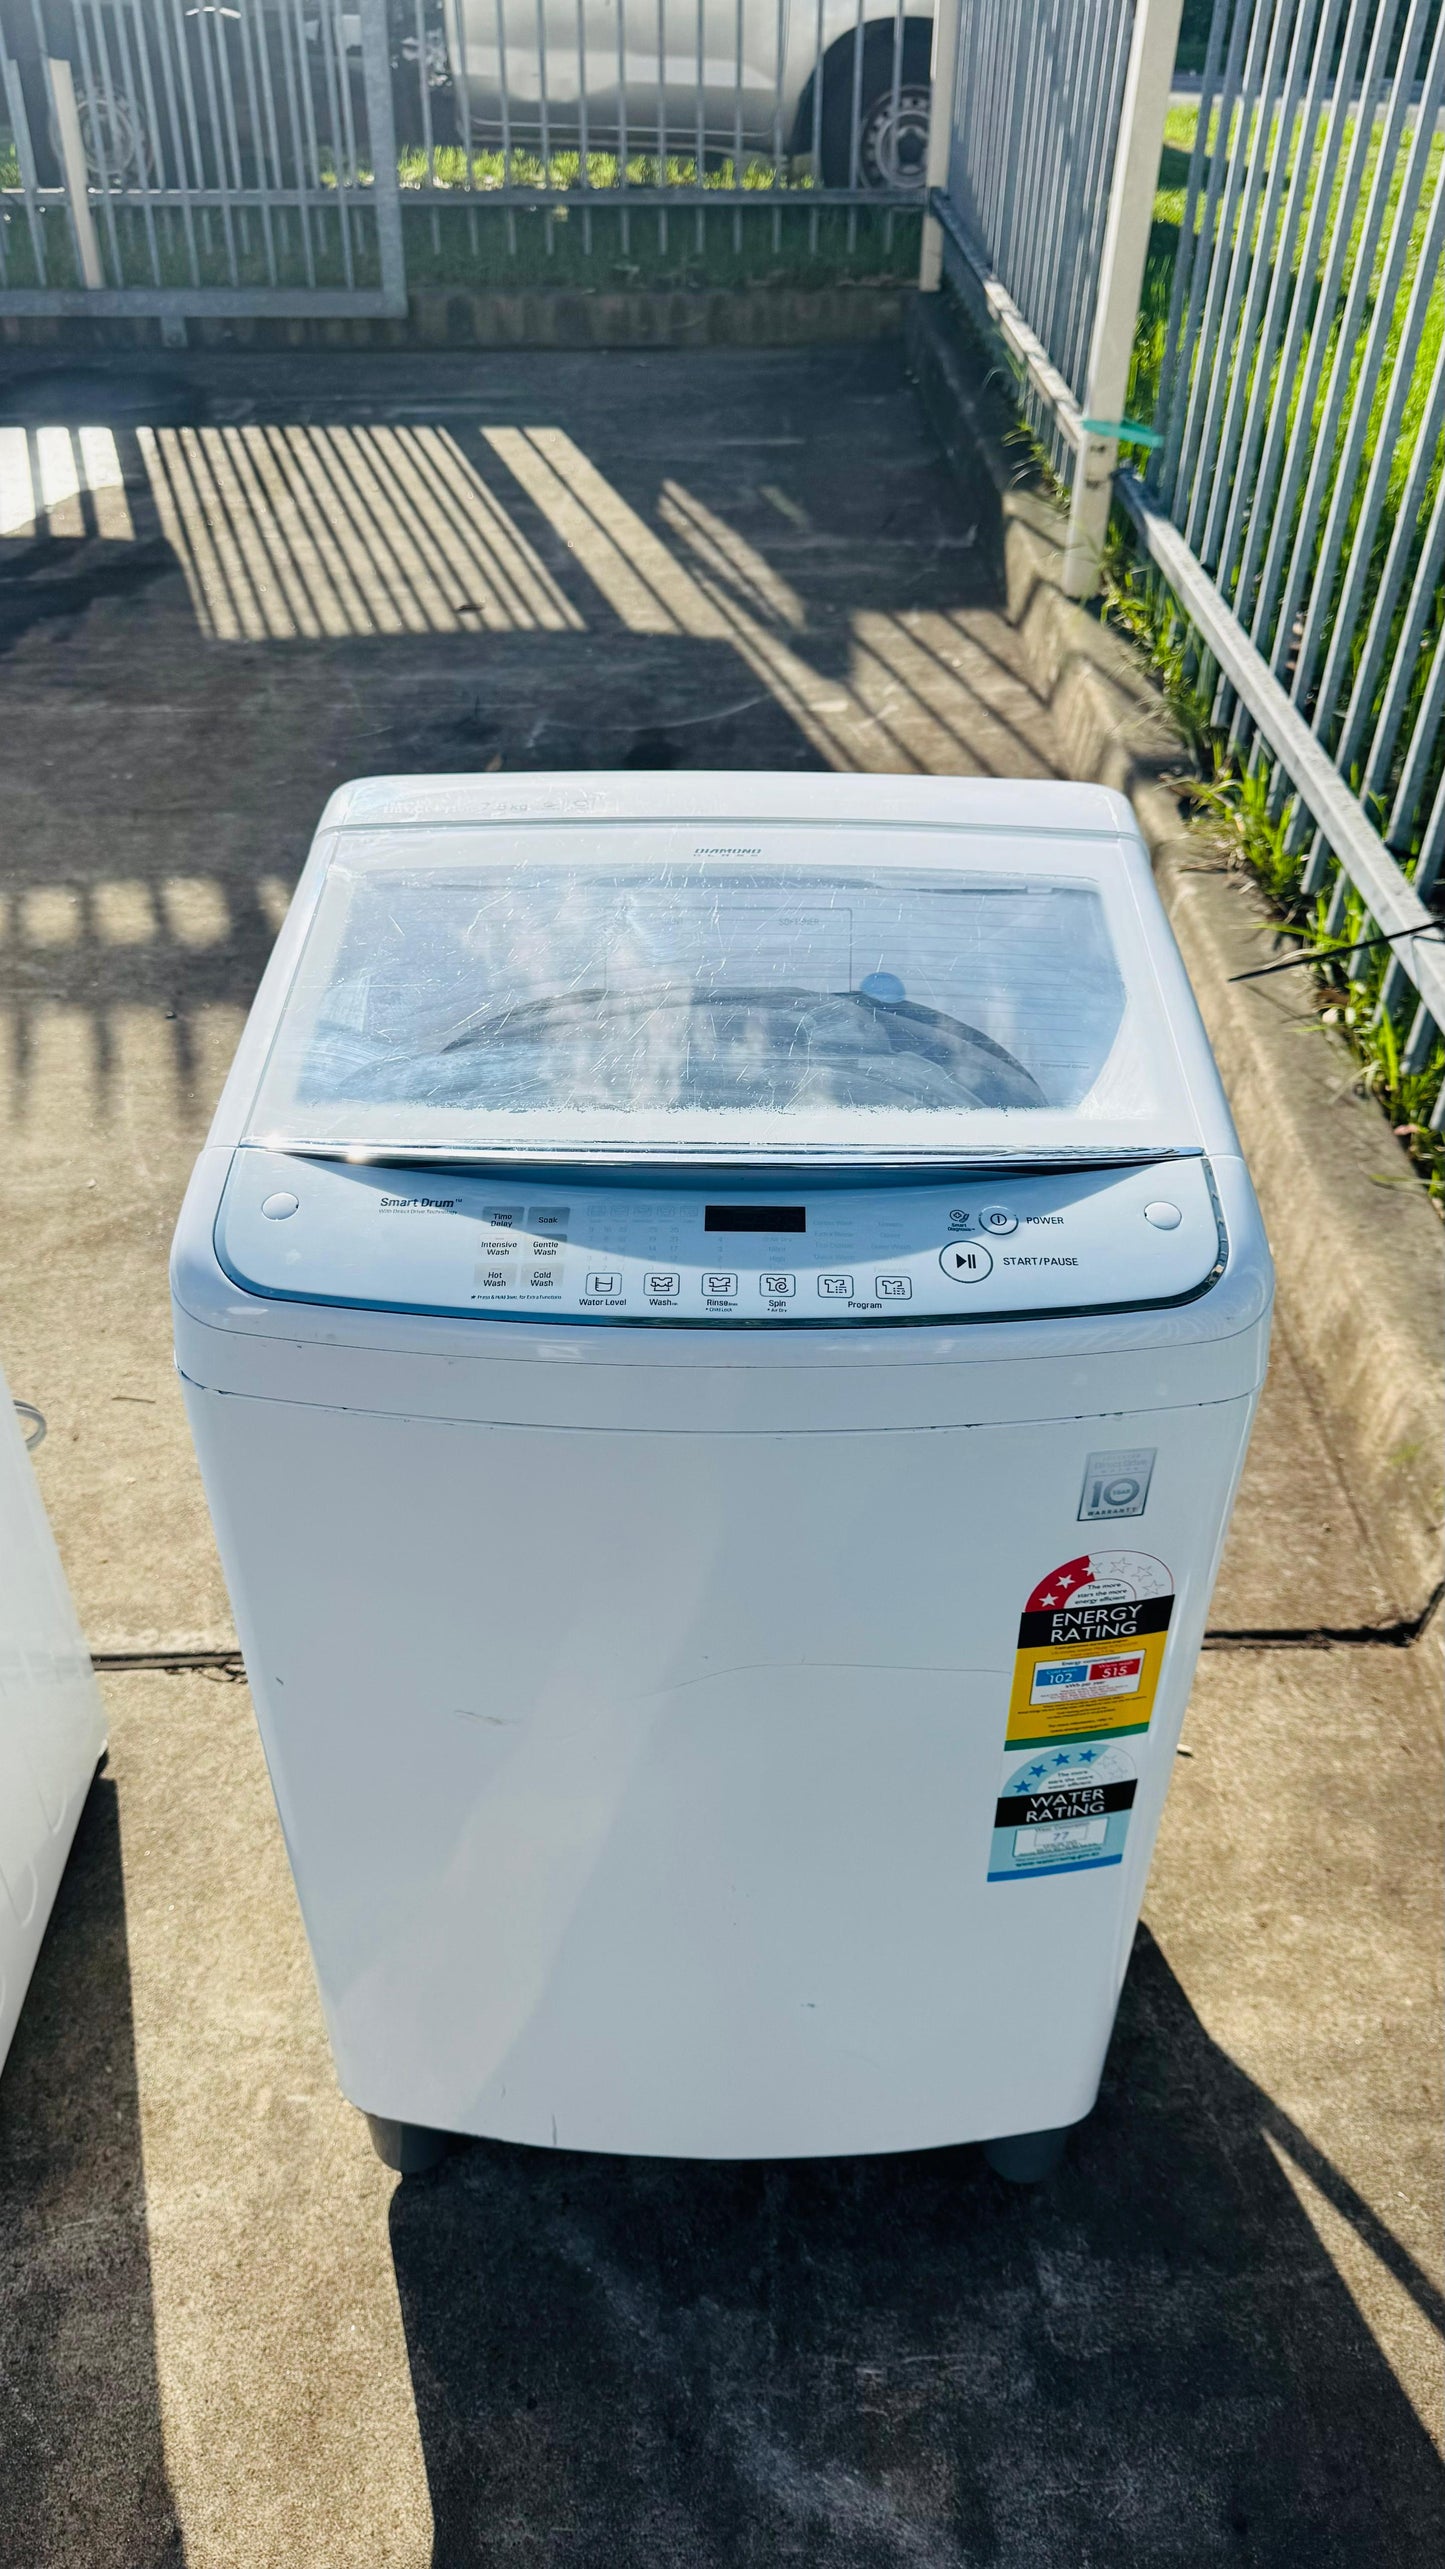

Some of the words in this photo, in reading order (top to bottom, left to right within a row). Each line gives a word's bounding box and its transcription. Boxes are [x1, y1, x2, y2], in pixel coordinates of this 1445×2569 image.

[380, 1198, 418, 1208] Smart
[493, 1212, 512, 1220] Time
[1026, 1216, 1065, 1225] POWER
[490, 1220, 513, 1229] Delay
[538, 1217, 559, 1225] Soak
[481, 1241, 518, 1249] Intensive
[533, 1241, 559, 1249] Gentle
[486, 1249, 510, 1257] Wash
[534, 1249, 558, 1257] Wash
[1003, 1257, 1080, 1266] START/PAUSE
[487, 1271, 503, 1279] Hot
[533, 1271, 552, 1279] Cold
[483, 1279, 507, 1288] Wash
[530, 1279, 554, 1288] Wash
[579, 1298, 604, 1307] Water
[605, 1298, 627, 1307] Level
[649, 1298, 672, 1307] Wash
[706, 1299, 729, 1307] Rinse
[768, 1299, 787, 1308] Spin
[847, 1300, 883, 1310] Program
[1090, 1478, 1140, 1508] 10
[1087, 1507, 1138, 1517] WARRANTY
[1051, 1604, 1143, 1628] ENERGY
[1050, 1621, 1138, 1643] RATING
[1102, 1665, 1129, 1679] 515
[1049, 1673, 1073, 1685] 102
[1030, 1789, 1105, 1809] WATER
[1026, 1801, 1105, 1823] RATING
